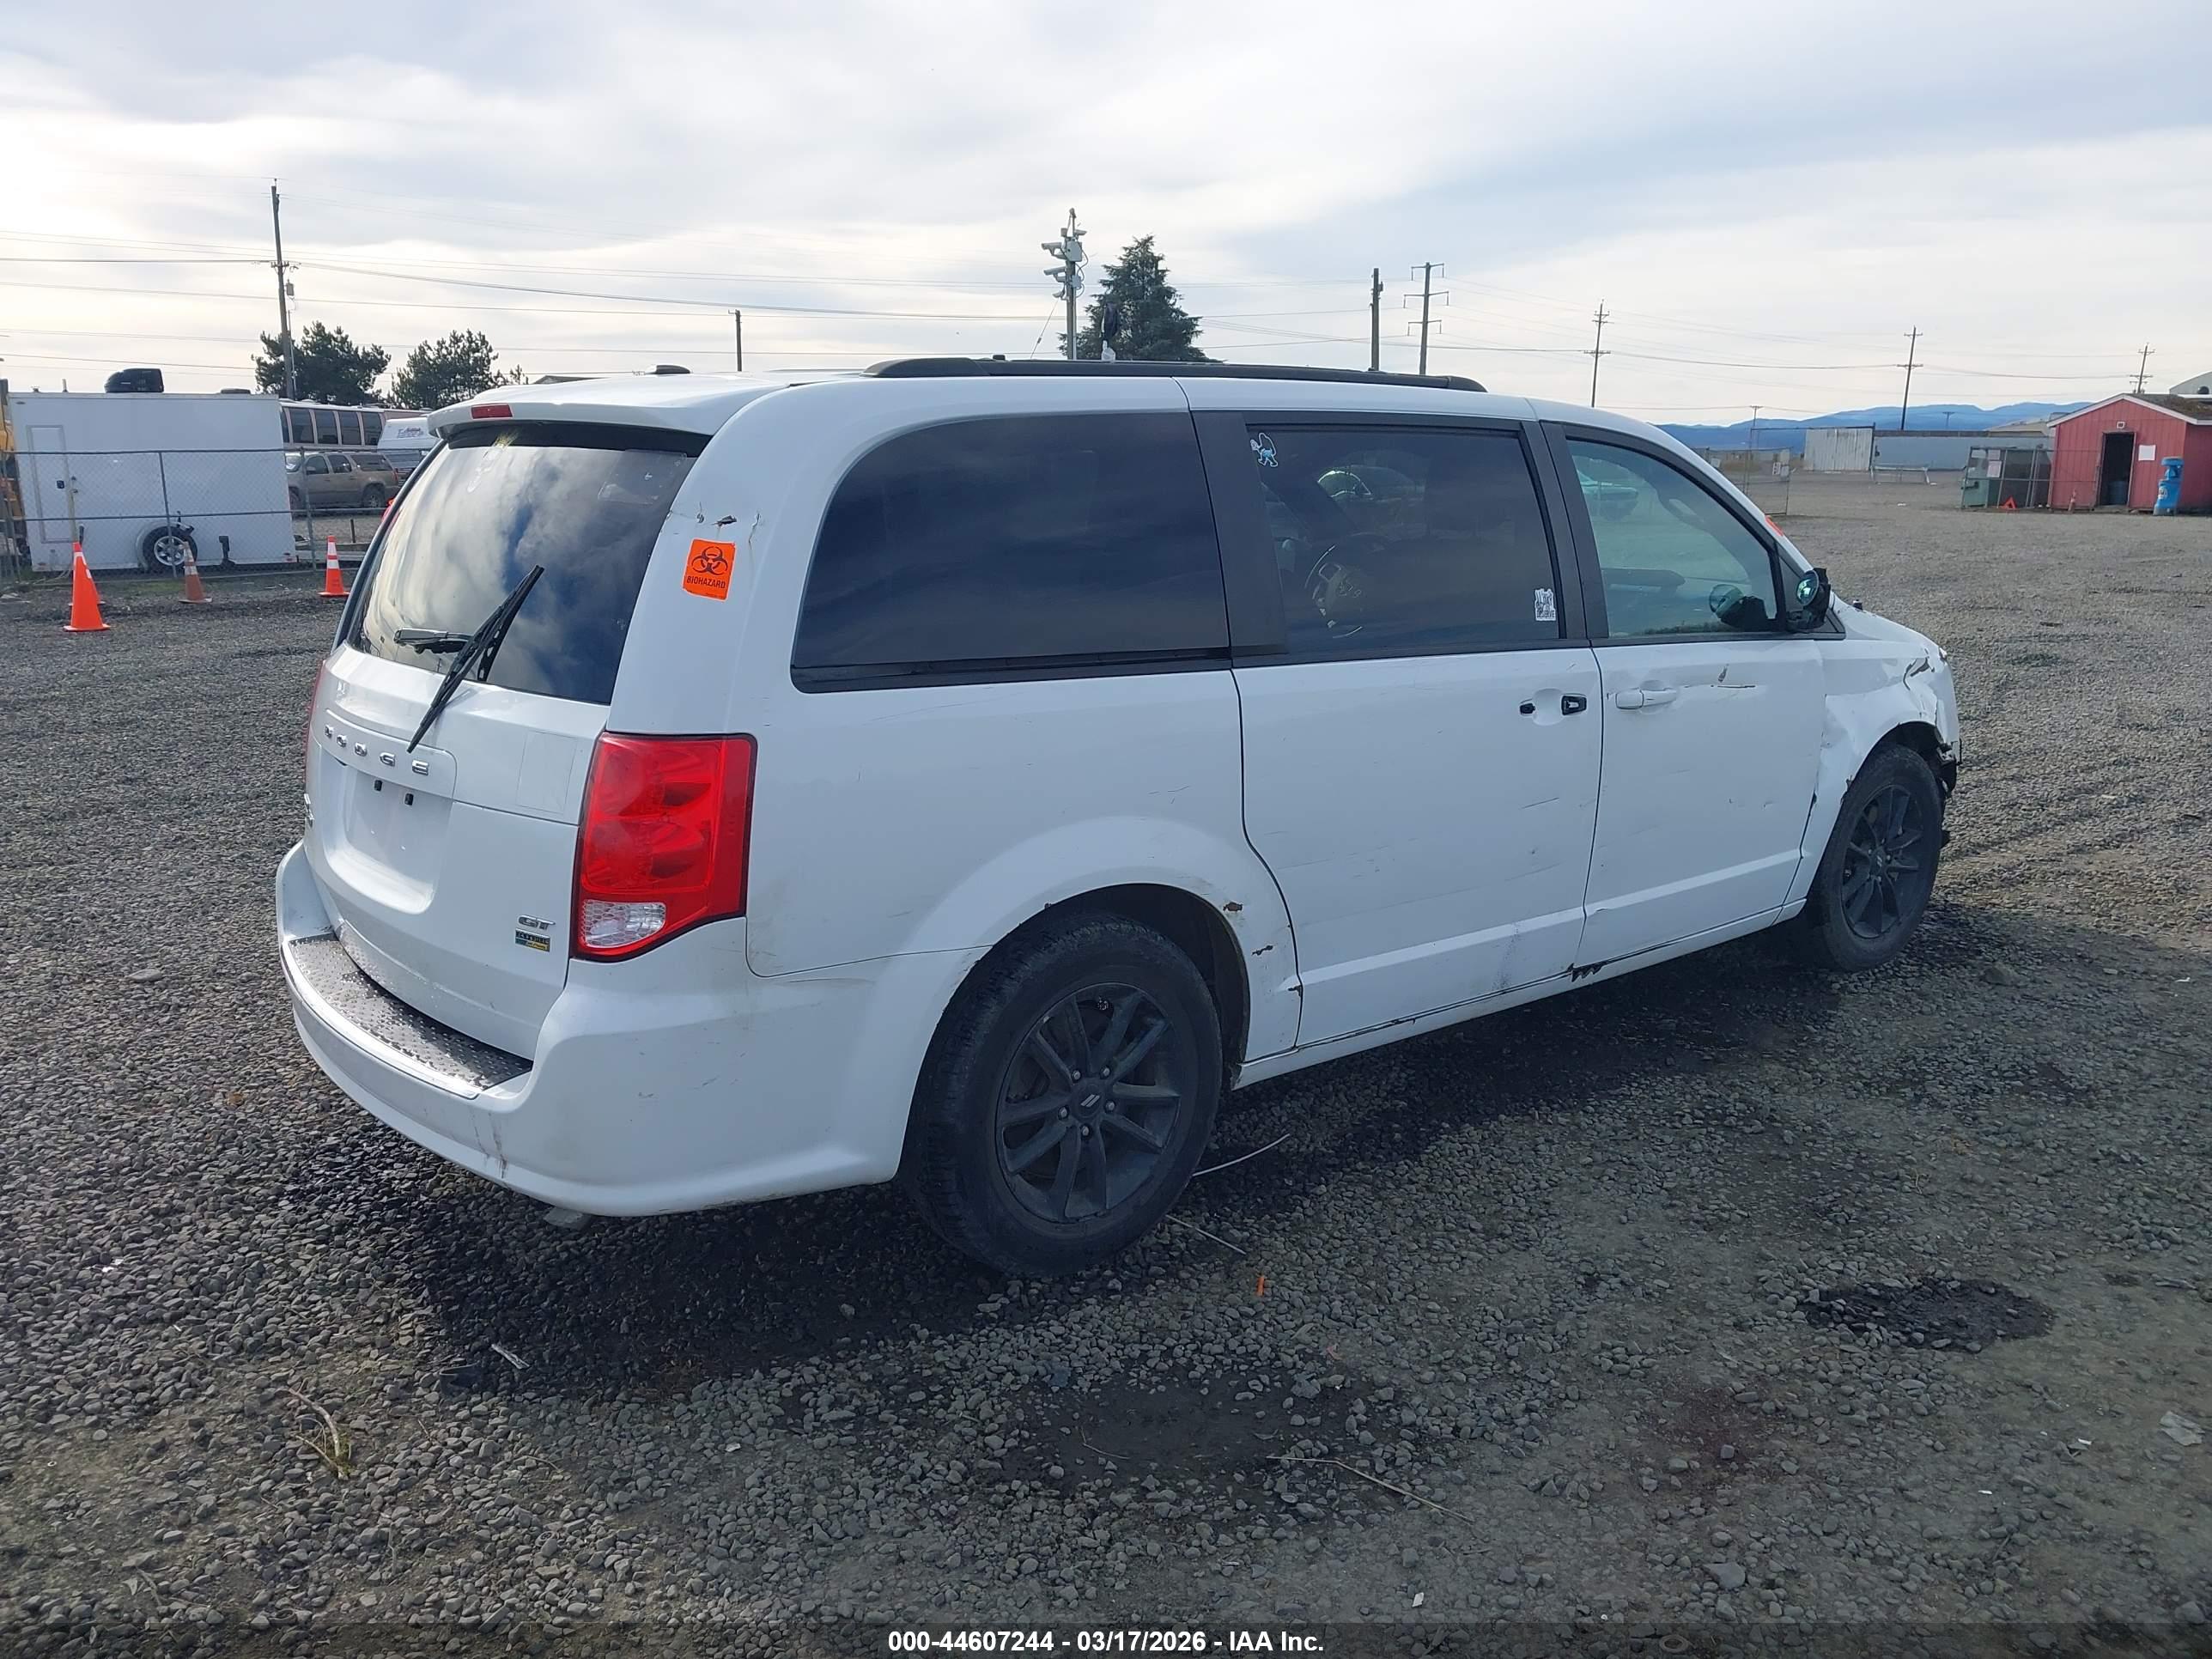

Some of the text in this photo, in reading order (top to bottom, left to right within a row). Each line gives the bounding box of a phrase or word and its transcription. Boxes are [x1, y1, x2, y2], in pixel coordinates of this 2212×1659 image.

[686, 575, 726, 589] BIOHAZARD
[324, 724, 429, 776] DODGE
[517, 914, 556, 931] GT
